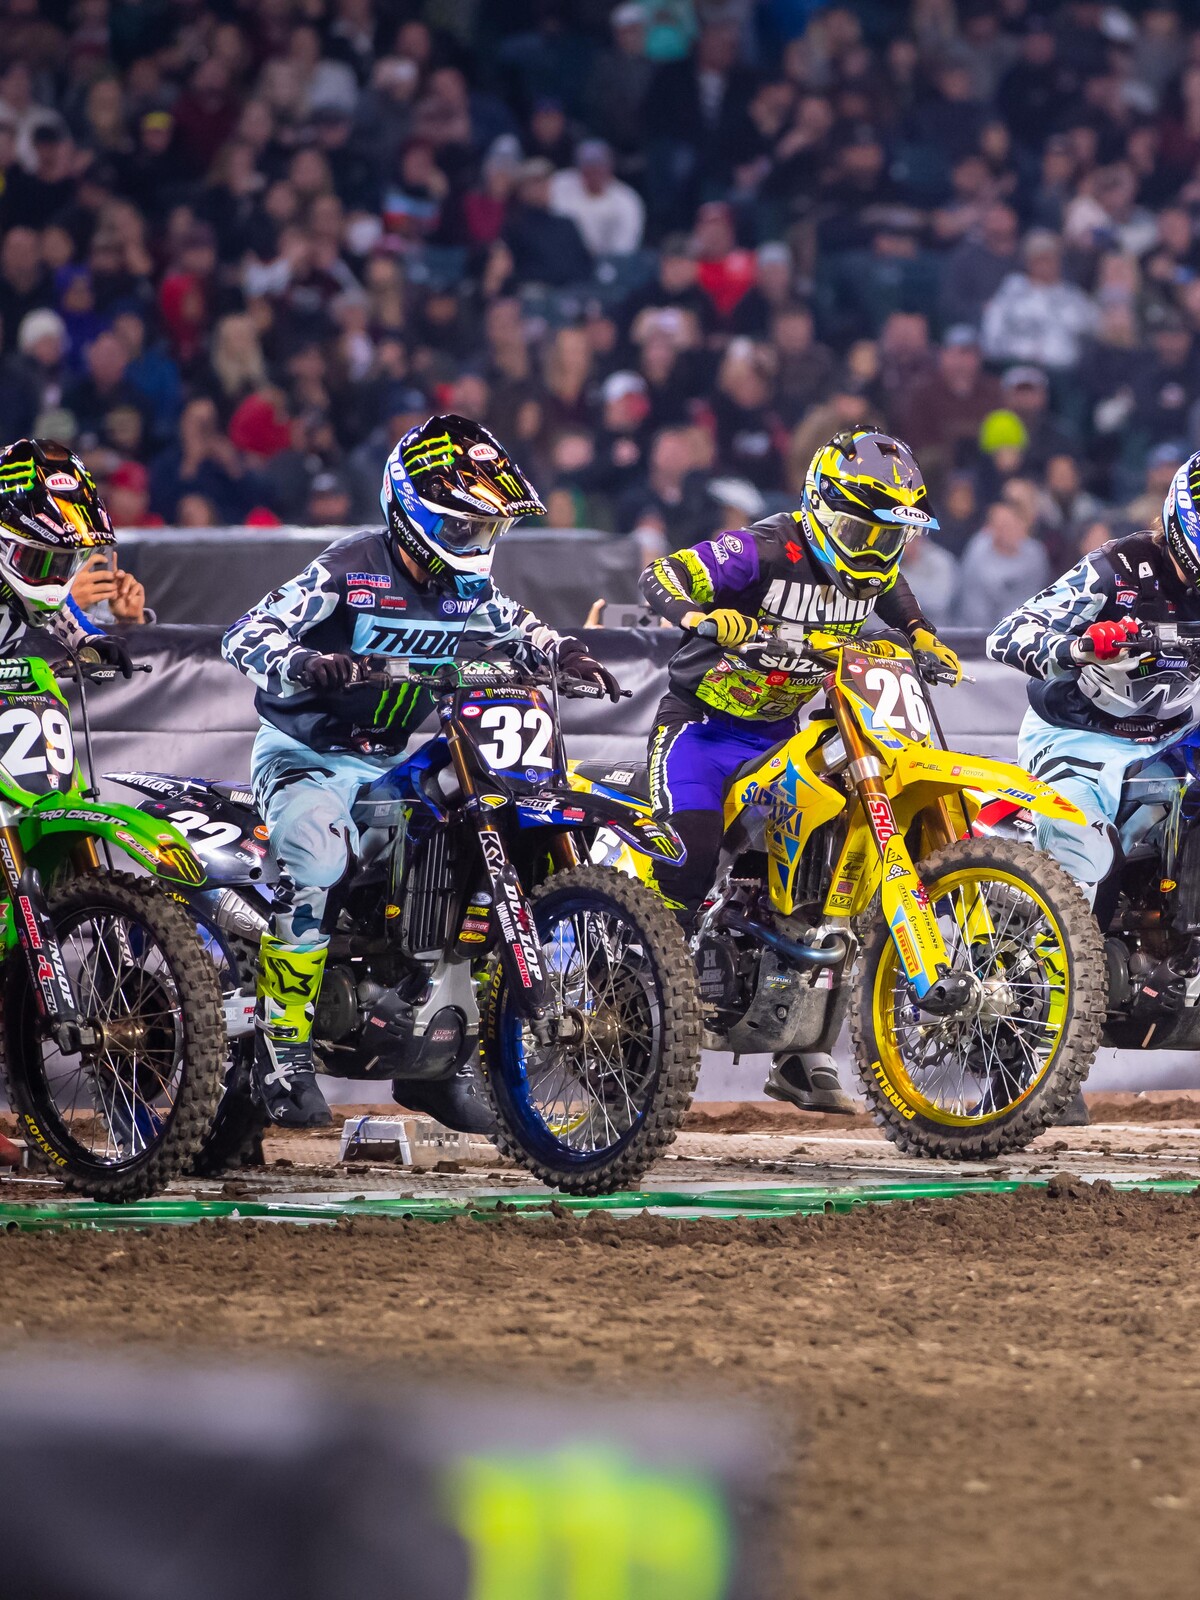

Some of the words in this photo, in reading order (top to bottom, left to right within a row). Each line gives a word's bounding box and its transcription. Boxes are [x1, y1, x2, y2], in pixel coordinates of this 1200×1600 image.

[473, 448, 494, 457] BELL
[51, 477, 74, 486] BELL
[901, 507, 928, 520] Arai
[62, 531, 115, 544] MOSTER
[392, 511, 430, 559] MONSTER
[1169, 522, 1198, 574] MONSTER
[347, 572, 391, 585] PARTS
[347, 580, 391, 588] UNLIMITED
[351, 592, 372, 606] 100%
[366, 625, 459, 656] THOR
[492, 687, 528, 697] MONSTER
[573, 685, 599, 695] ARC
[865, 668, 930, 742] 26
[0, 708, 74, 776] 29
[478, 705, 554, 770] 32
[604, 770, 635, 786] JGR
[915, 761, 943, 771] FUEL
[962, 769, 985, 777] TOYOTA
[116, 773, 173, 795] DUNLOP
[996, 787, 1037, 803] JGR
[39, 808, 66, 821] PRO
[65, 808, 128, 827] CIRCUIT
[868, 800, 896, 852] SHO
[19, 896, 43, 949] BRAKING
[496, 901, 516, 944] YAMALUBE
[922, 910, 941, 950] PISTONS
[912, 922, 926, 951] SCOTT
[895, 925, 920, 975] PIRELLI
[513, 943, 532, 988] BRAKING
[766, 975, 793, 985] SUZUKI
[487, 963, 503, 1040] DUNLOP
[872, 1061, 917, 1121] PIRELLI
[23, 1113, 69, 1168] DUNLOP
